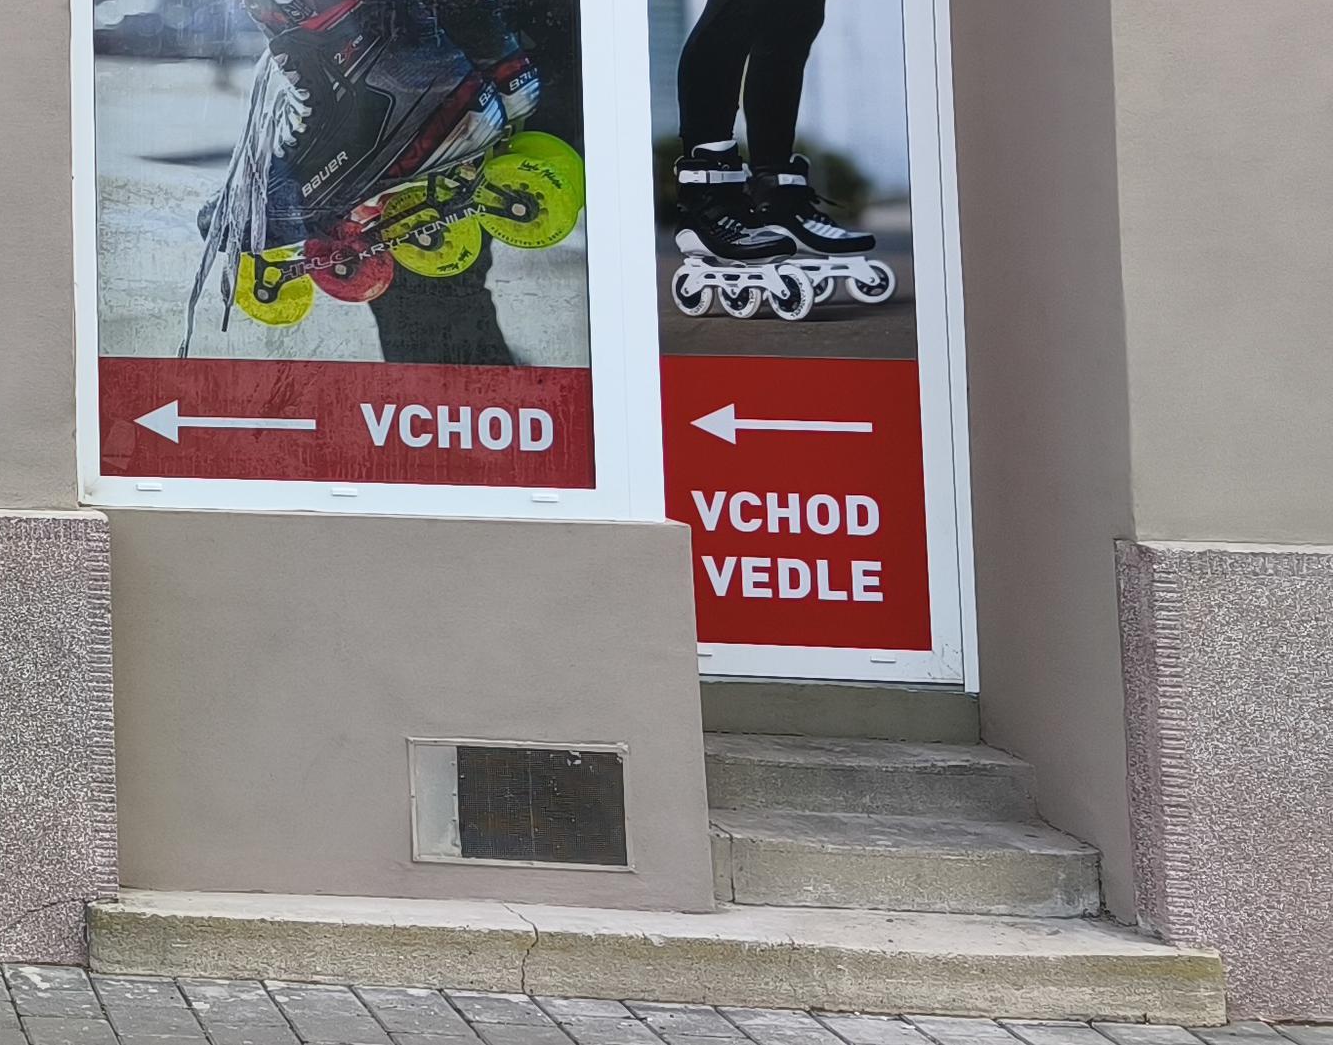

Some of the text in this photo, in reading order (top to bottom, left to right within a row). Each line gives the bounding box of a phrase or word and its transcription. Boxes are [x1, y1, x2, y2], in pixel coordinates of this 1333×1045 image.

[360, 402, 555, 452] VCHOD
[691, 489, 881, 536] VCHOD
[701, 555, 885, 603] VEDLE
